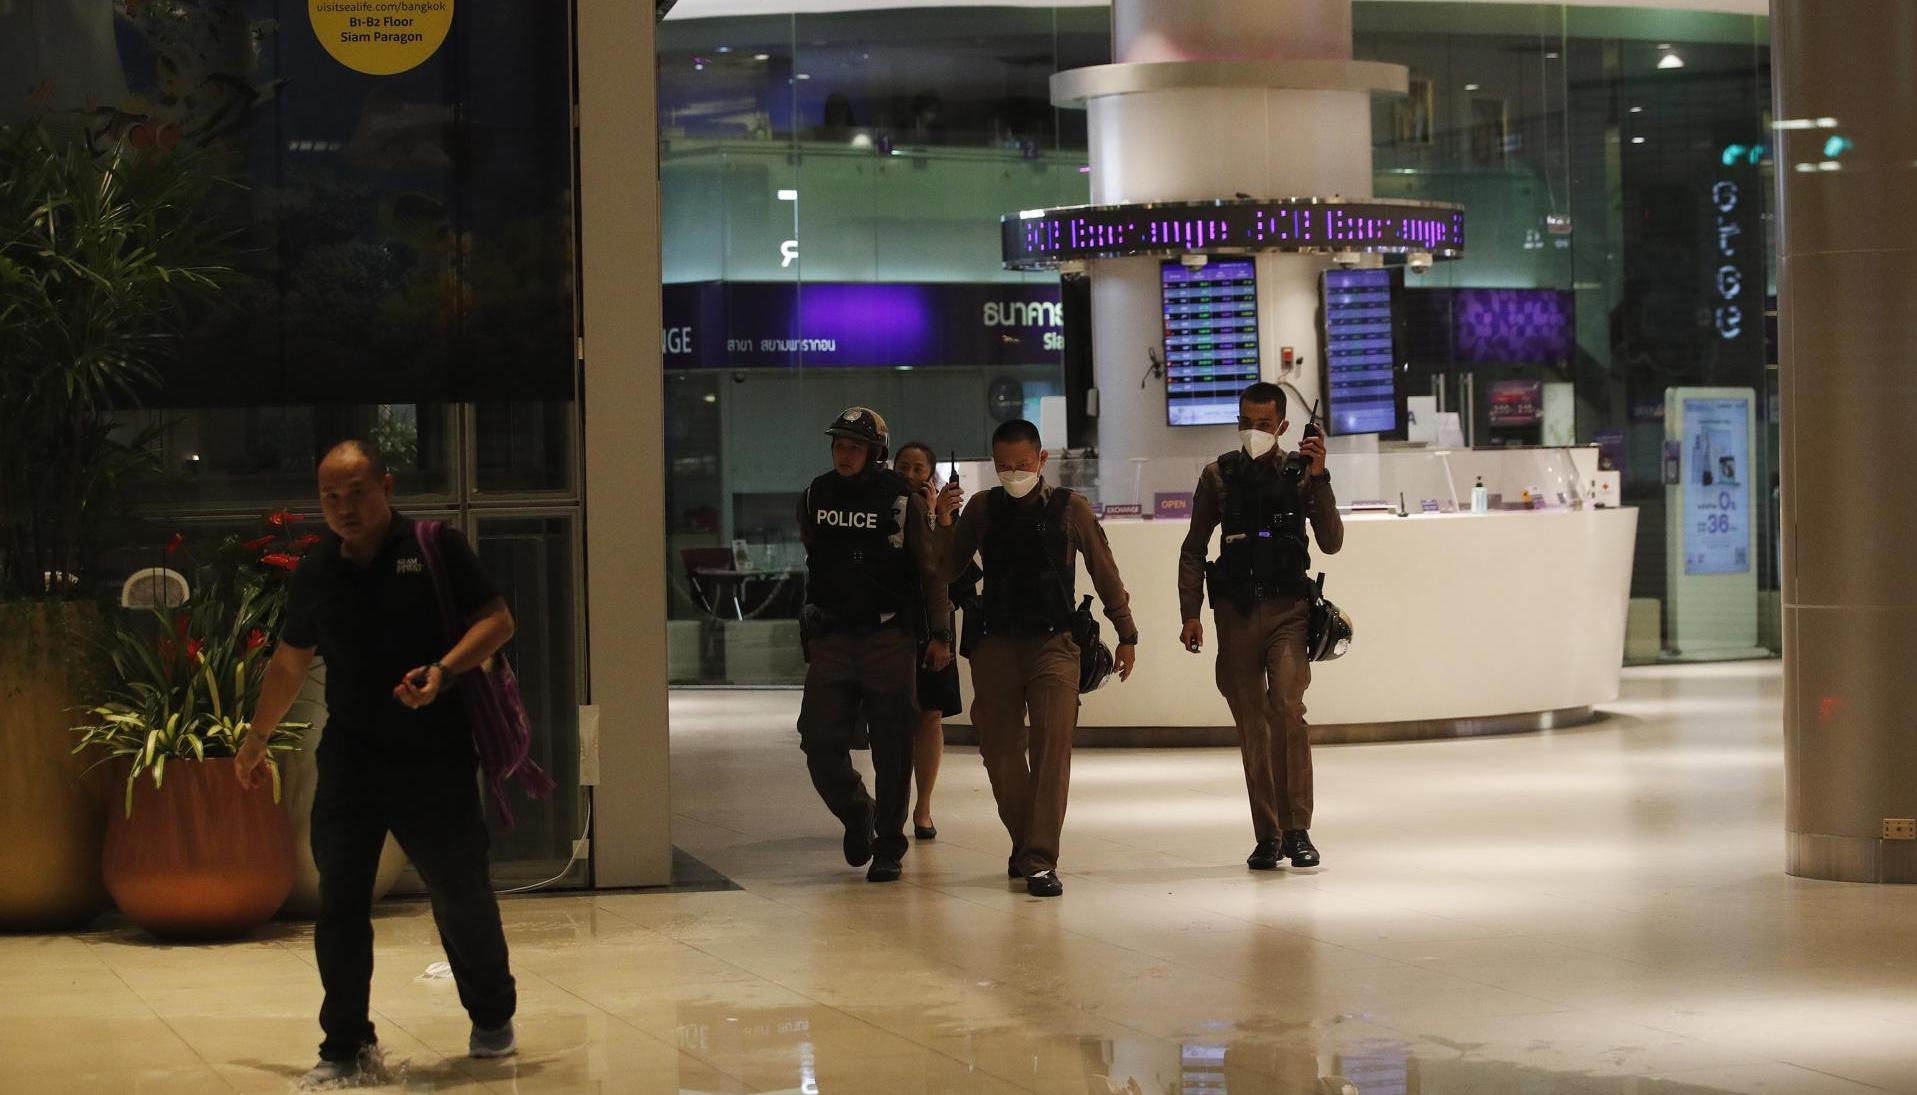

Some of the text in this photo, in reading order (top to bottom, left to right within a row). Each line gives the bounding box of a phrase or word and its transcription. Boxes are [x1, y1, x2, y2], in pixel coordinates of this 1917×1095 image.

[316, 1, 446, 13] visitsealife.com/bangkok
[349, 16, 414, 27] B1-B2 Floor
[340, 32, 423, 44] Siam Paragon
[1160, 499, 1187, 510] OPEN
[816, 509, 879, 530] POLICE
[1707, 513, 1730, 534] 36
